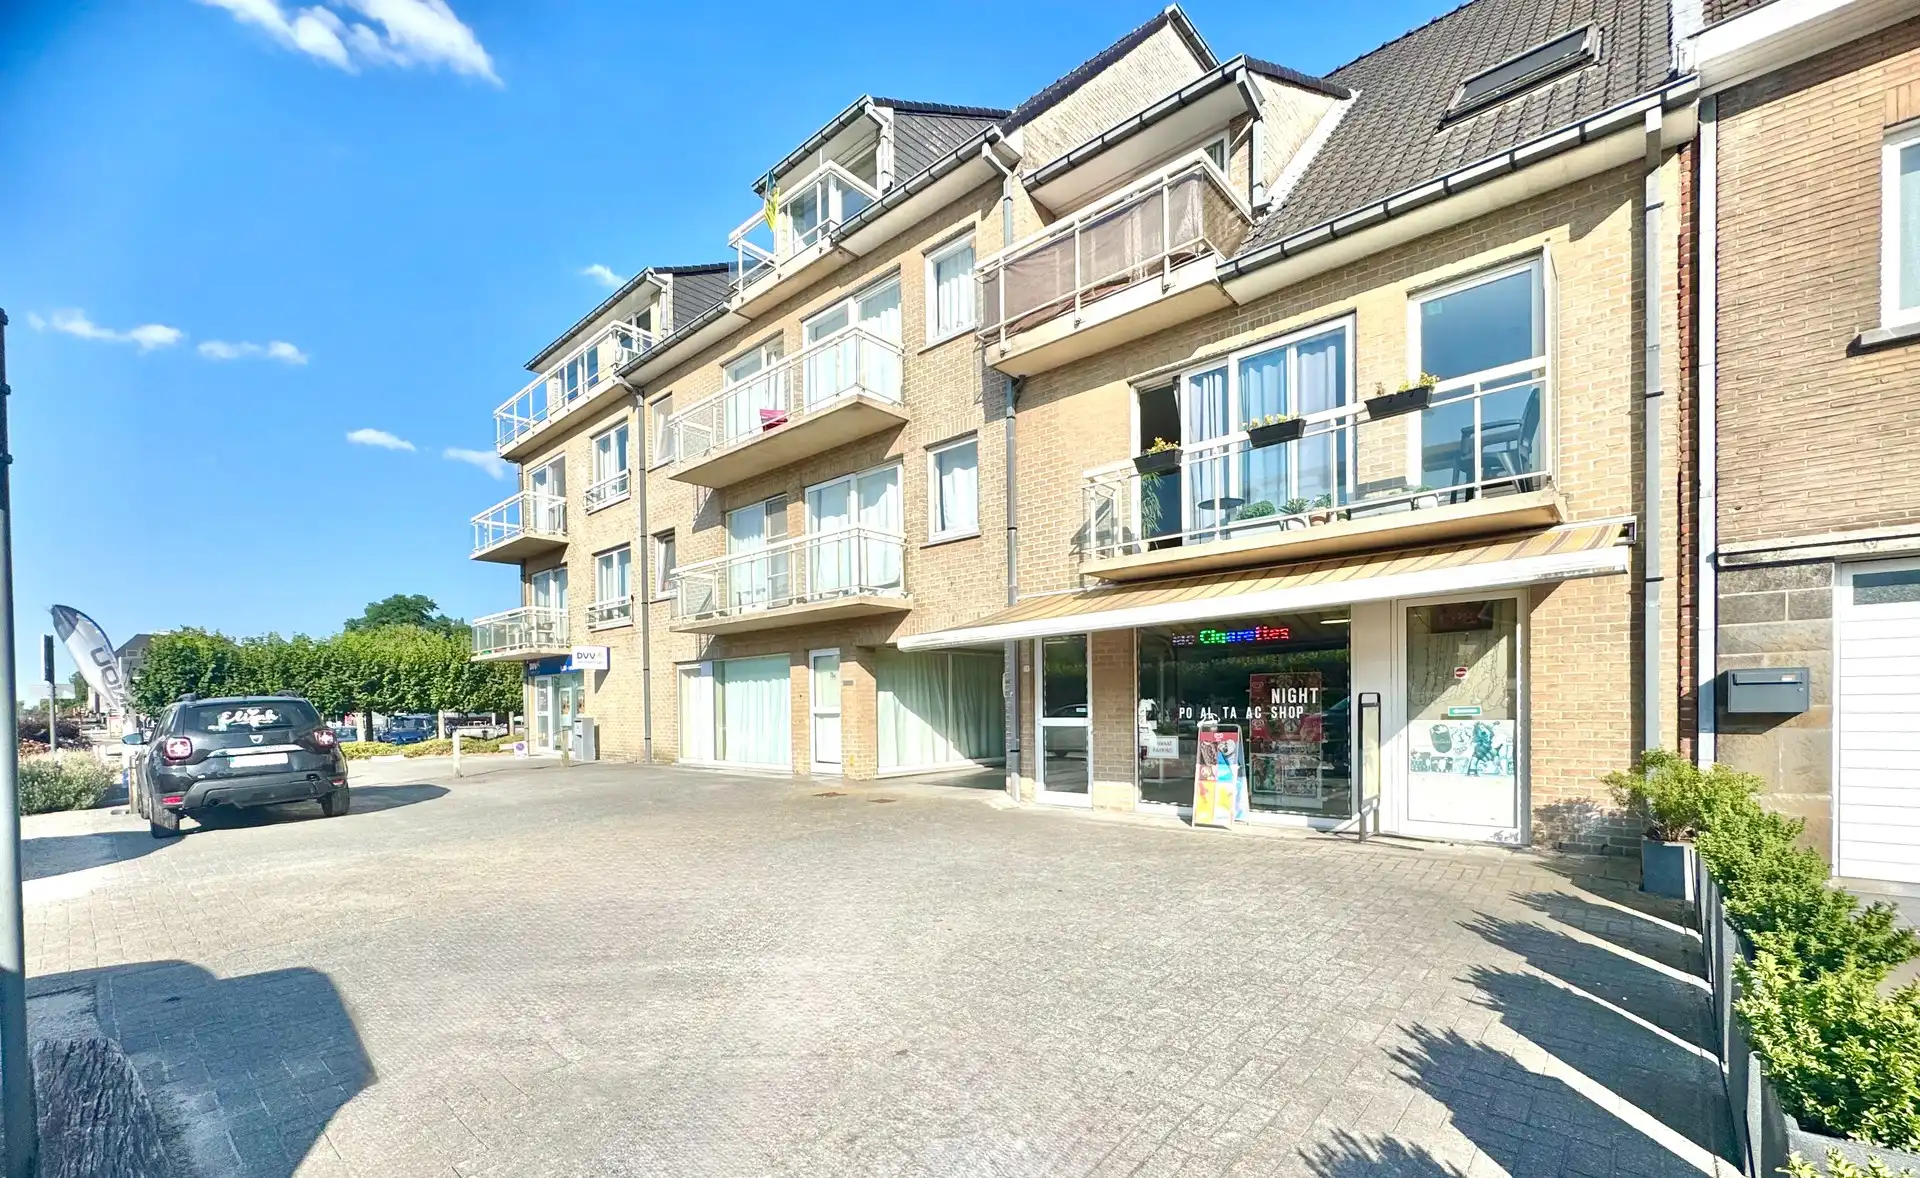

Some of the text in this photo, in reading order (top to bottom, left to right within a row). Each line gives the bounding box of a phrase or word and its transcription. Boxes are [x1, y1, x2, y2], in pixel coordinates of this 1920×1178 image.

[576, 652, 596, 660] DVV
[1271, 687, 1319, 704] NIGHT
[1270, 706, 1304, 719] SHOP
